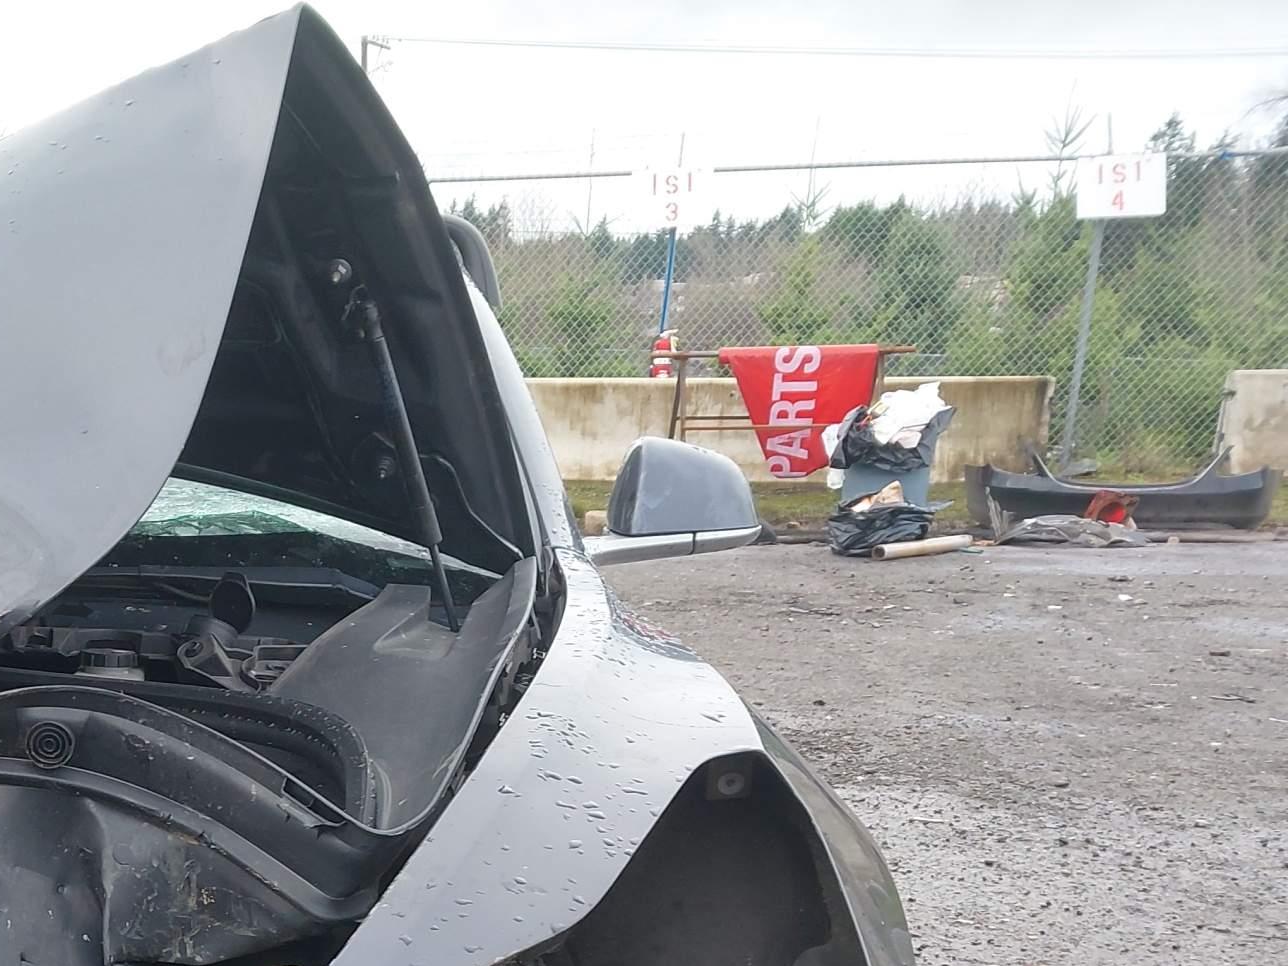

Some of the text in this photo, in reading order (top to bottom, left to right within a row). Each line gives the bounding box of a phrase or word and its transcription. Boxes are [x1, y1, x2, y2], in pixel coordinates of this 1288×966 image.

[1111, 190, 1124, 210] 4
[665, 202, 678, 221] 3
[766, 346, 821, 478] PARTS
